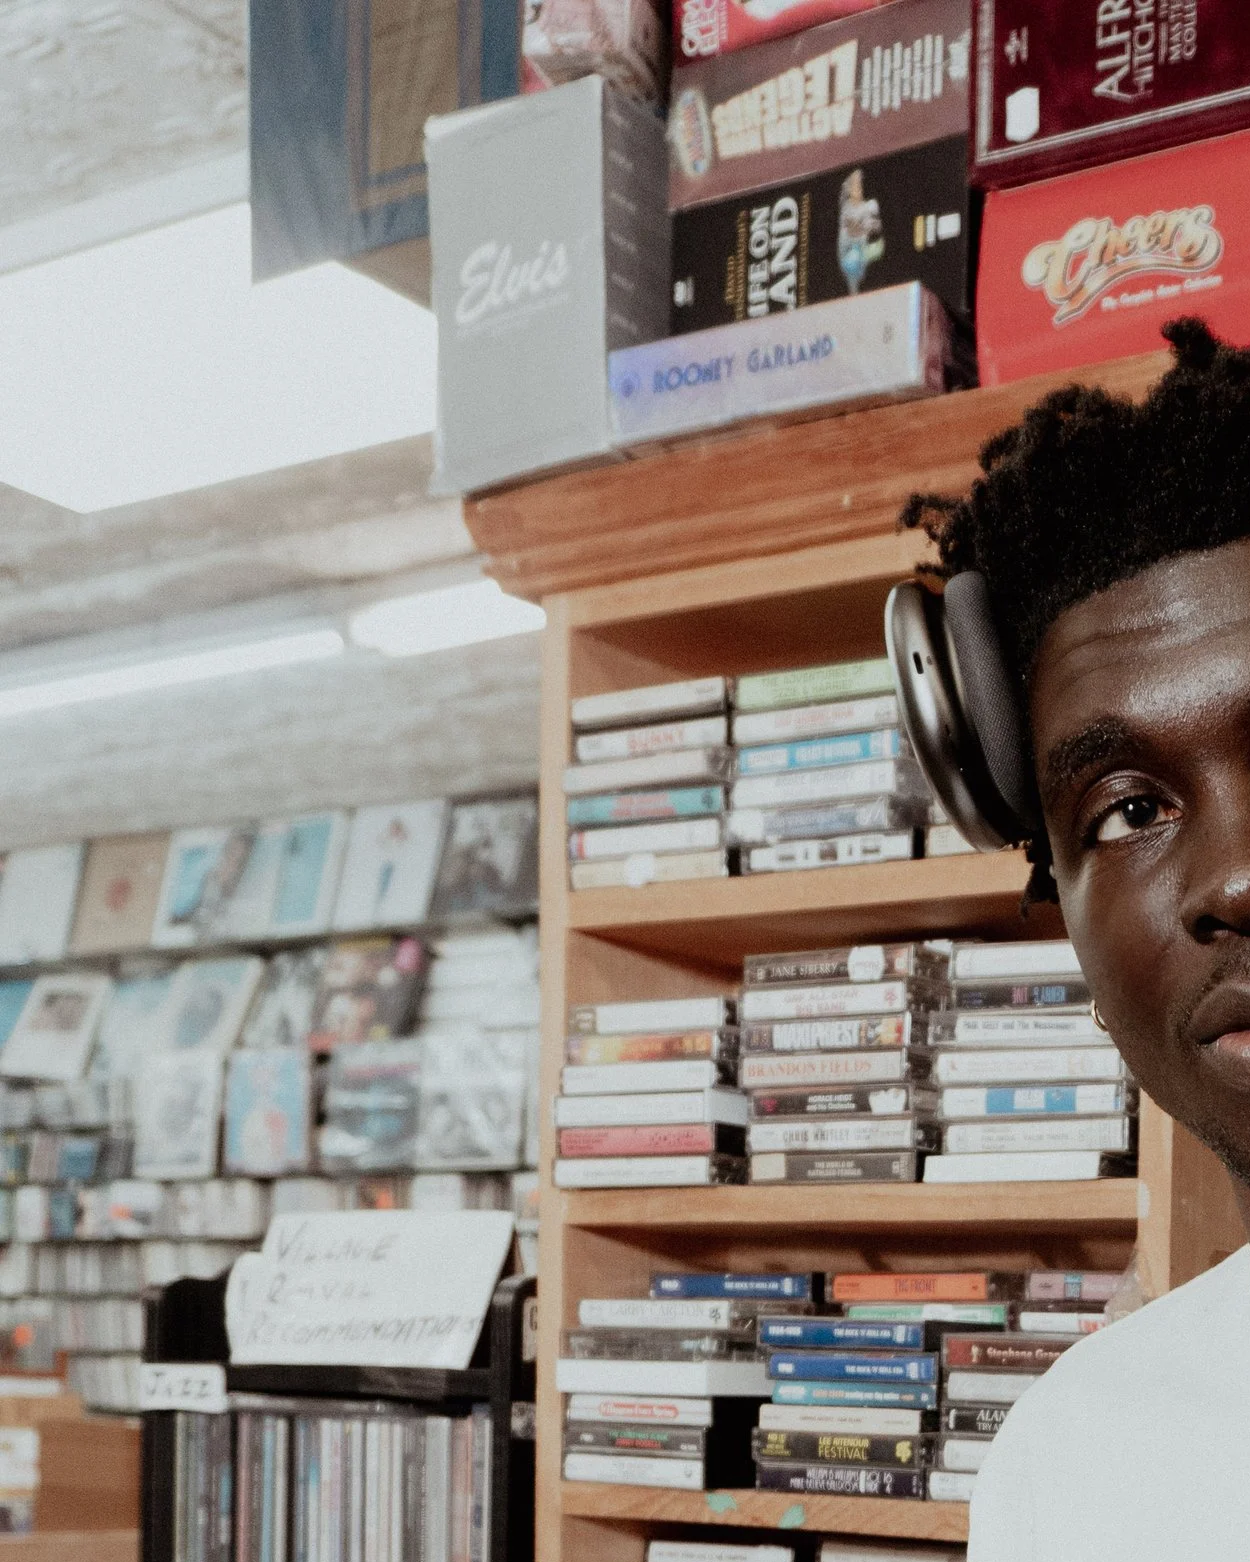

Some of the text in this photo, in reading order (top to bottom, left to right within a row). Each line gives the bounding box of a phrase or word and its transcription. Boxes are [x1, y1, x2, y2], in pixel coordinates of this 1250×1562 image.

[749, 205, 771, 319] IFE ON
[1022, 203, 1224, 324] Cheers
[454, 241, 568, 327] Elvis
[652, 334, 833, 395] ROONEY GARLAND
[770, 965, 797, 978] JANE
[747, 1059, 871, 1079] BRANDON FIELDS
[910, 1278, 937, 1294] FRONT
[986, 1346, 1033, 1364] Stephane
[856, 1365, 871, 1375] ROCK
[977, 1422, 992, 1432] TRY
[818, 1436, 831, 1446] LEE
[818, 1447, 868, 1461] FESTIVAL
